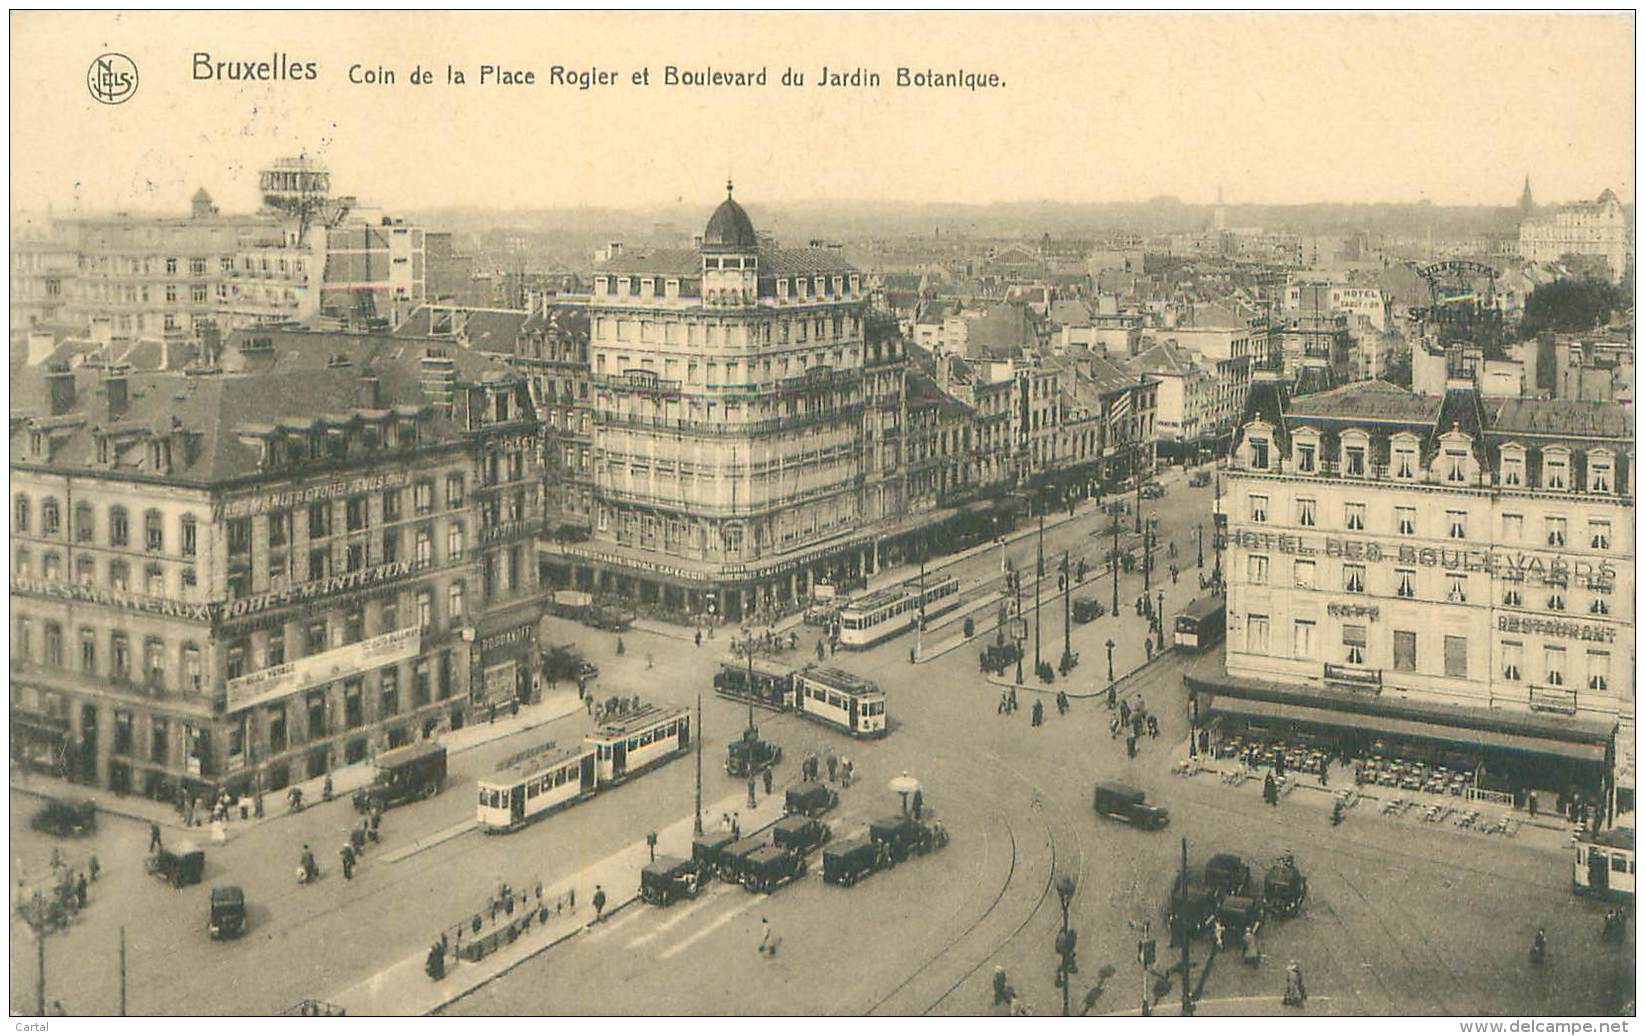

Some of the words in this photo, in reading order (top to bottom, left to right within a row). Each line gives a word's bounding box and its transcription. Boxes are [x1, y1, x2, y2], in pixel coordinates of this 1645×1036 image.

[1343, 290, 1377, 299] HOTEL
[1326, 537, 1383, 562] DES
[1399, 543, 1617, 578] BOULEVARDS
[1498, 616, 1617, 645] RESTAURANT
